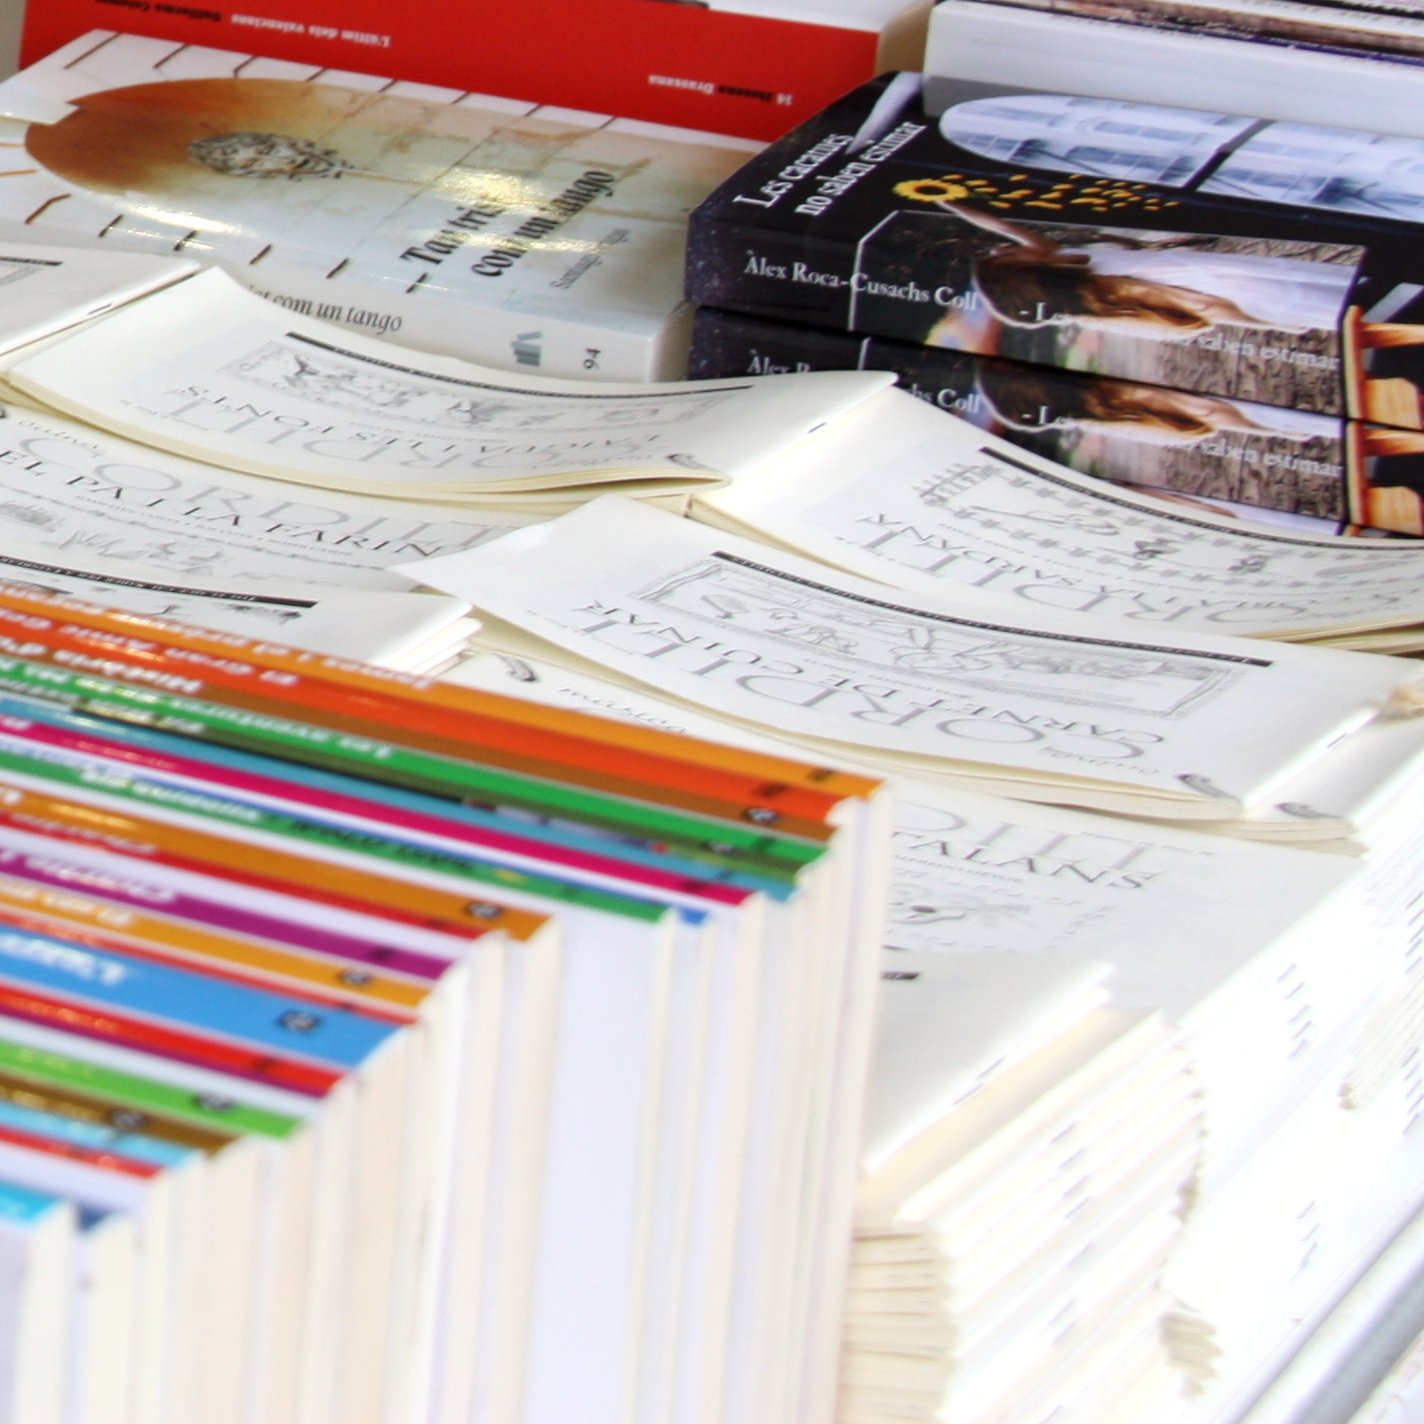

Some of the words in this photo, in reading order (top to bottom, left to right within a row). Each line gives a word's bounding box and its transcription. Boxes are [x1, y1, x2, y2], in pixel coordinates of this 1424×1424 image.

[231, 13, 304, 35] valencians
[308, 24, 337, 39] dels
[342, 29, 391, 48] L'últim
[794, 196, 833, 217] no
[817, 162, 878, 197] saben
[859, 121, 928, 163] estimar
[732, 180, 794, 209] Les
[400, 224, 464, 266] Tan
[744, 250, 787, 279] Àlex
[792, 261, 930, 302] Roca-Cusachs
[934, 286, 978, 312] Coll
[317, 302, 342, 321] un
[345, 306, 402, 335] tango
[67, 476, 125, 500] PA
[146, 498, 166, 508] I
[182, 507, 242, 527] LA
[855, 512, 1076, 587] SARDANA
[60, 625, 156, 653] Amic
[54, 650, 200, 694] Història
[165, 649, 252, 675] Gran
[819, 676, 899, 701] DE
[918, 697, 1164, 744] CARNET
